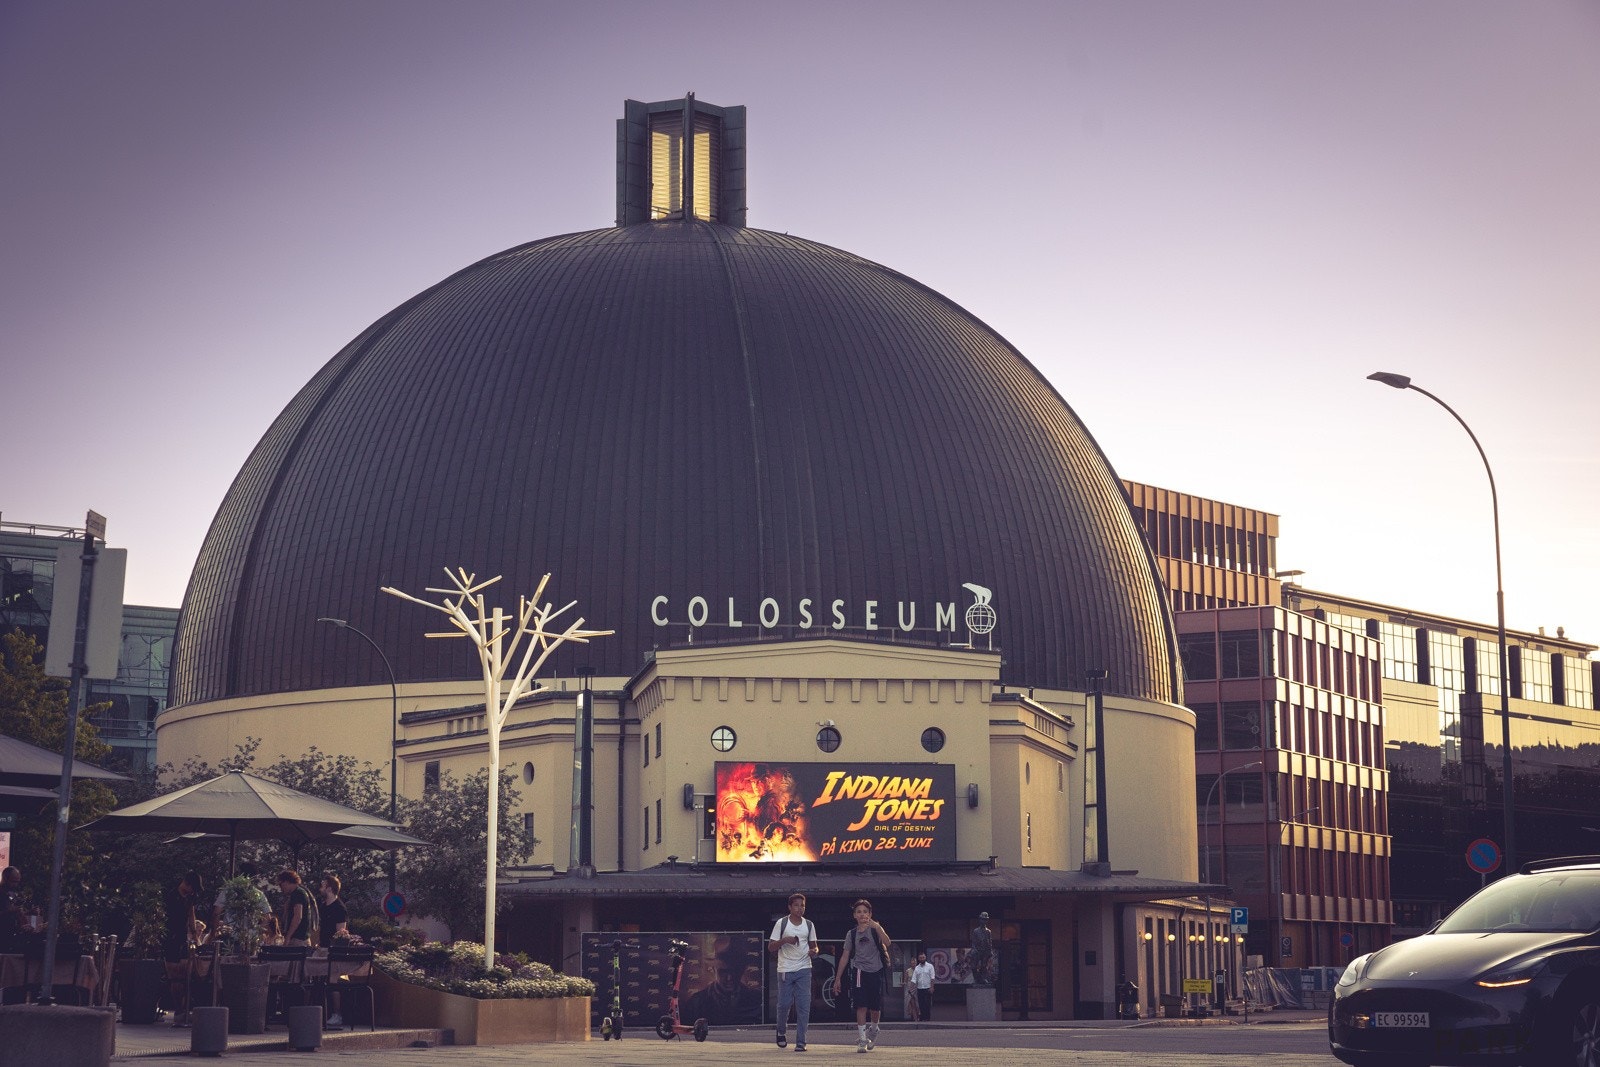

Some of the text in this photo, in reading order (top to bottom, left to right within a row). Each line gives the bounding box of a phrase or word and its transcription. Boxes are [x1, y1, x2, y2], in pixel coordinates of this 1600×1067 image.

[650, 595, 956, 632] COLOSSEUM
[811, 771, 933, 808] INDIANA
[846, 798, 945, 831] JONES
[819, 836, 933, 856] PÅ KINO 28. JUNI
[1234, 910, 1243, 923] P
[1377, 1014, 1426, 1026] EC 99594
